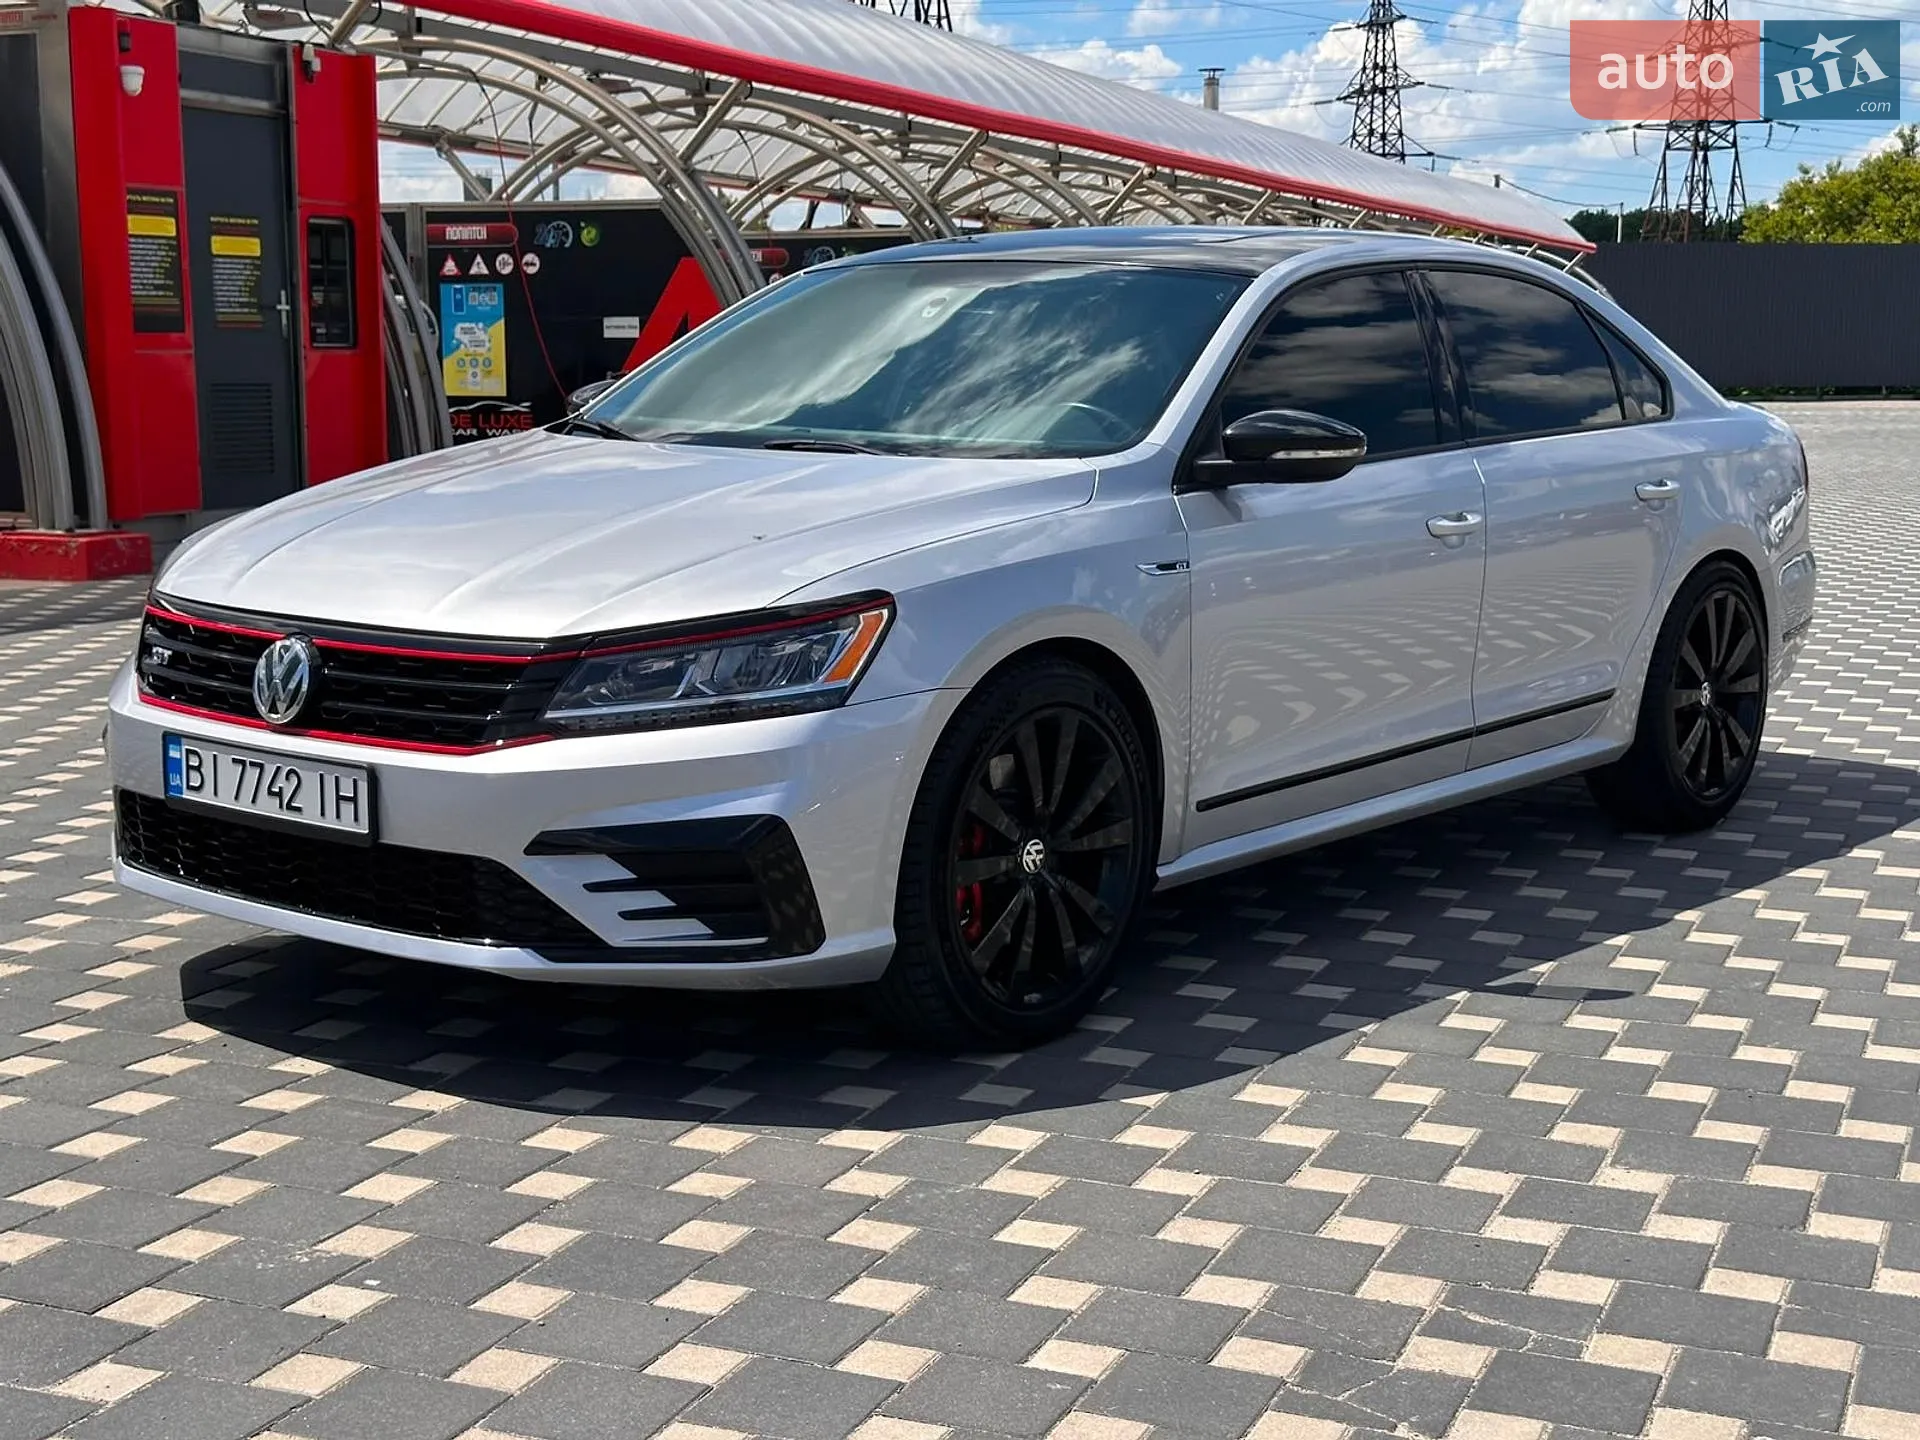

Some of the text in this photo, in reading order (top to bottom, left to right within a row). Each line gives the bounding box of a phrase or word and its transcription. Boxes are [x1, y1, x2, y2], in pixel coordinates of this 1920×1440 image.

[478, 414, 533, 428] LUXE
[170, 774, 182, 786] UA
[184, 747, 360, 824] BI 7742 IH
